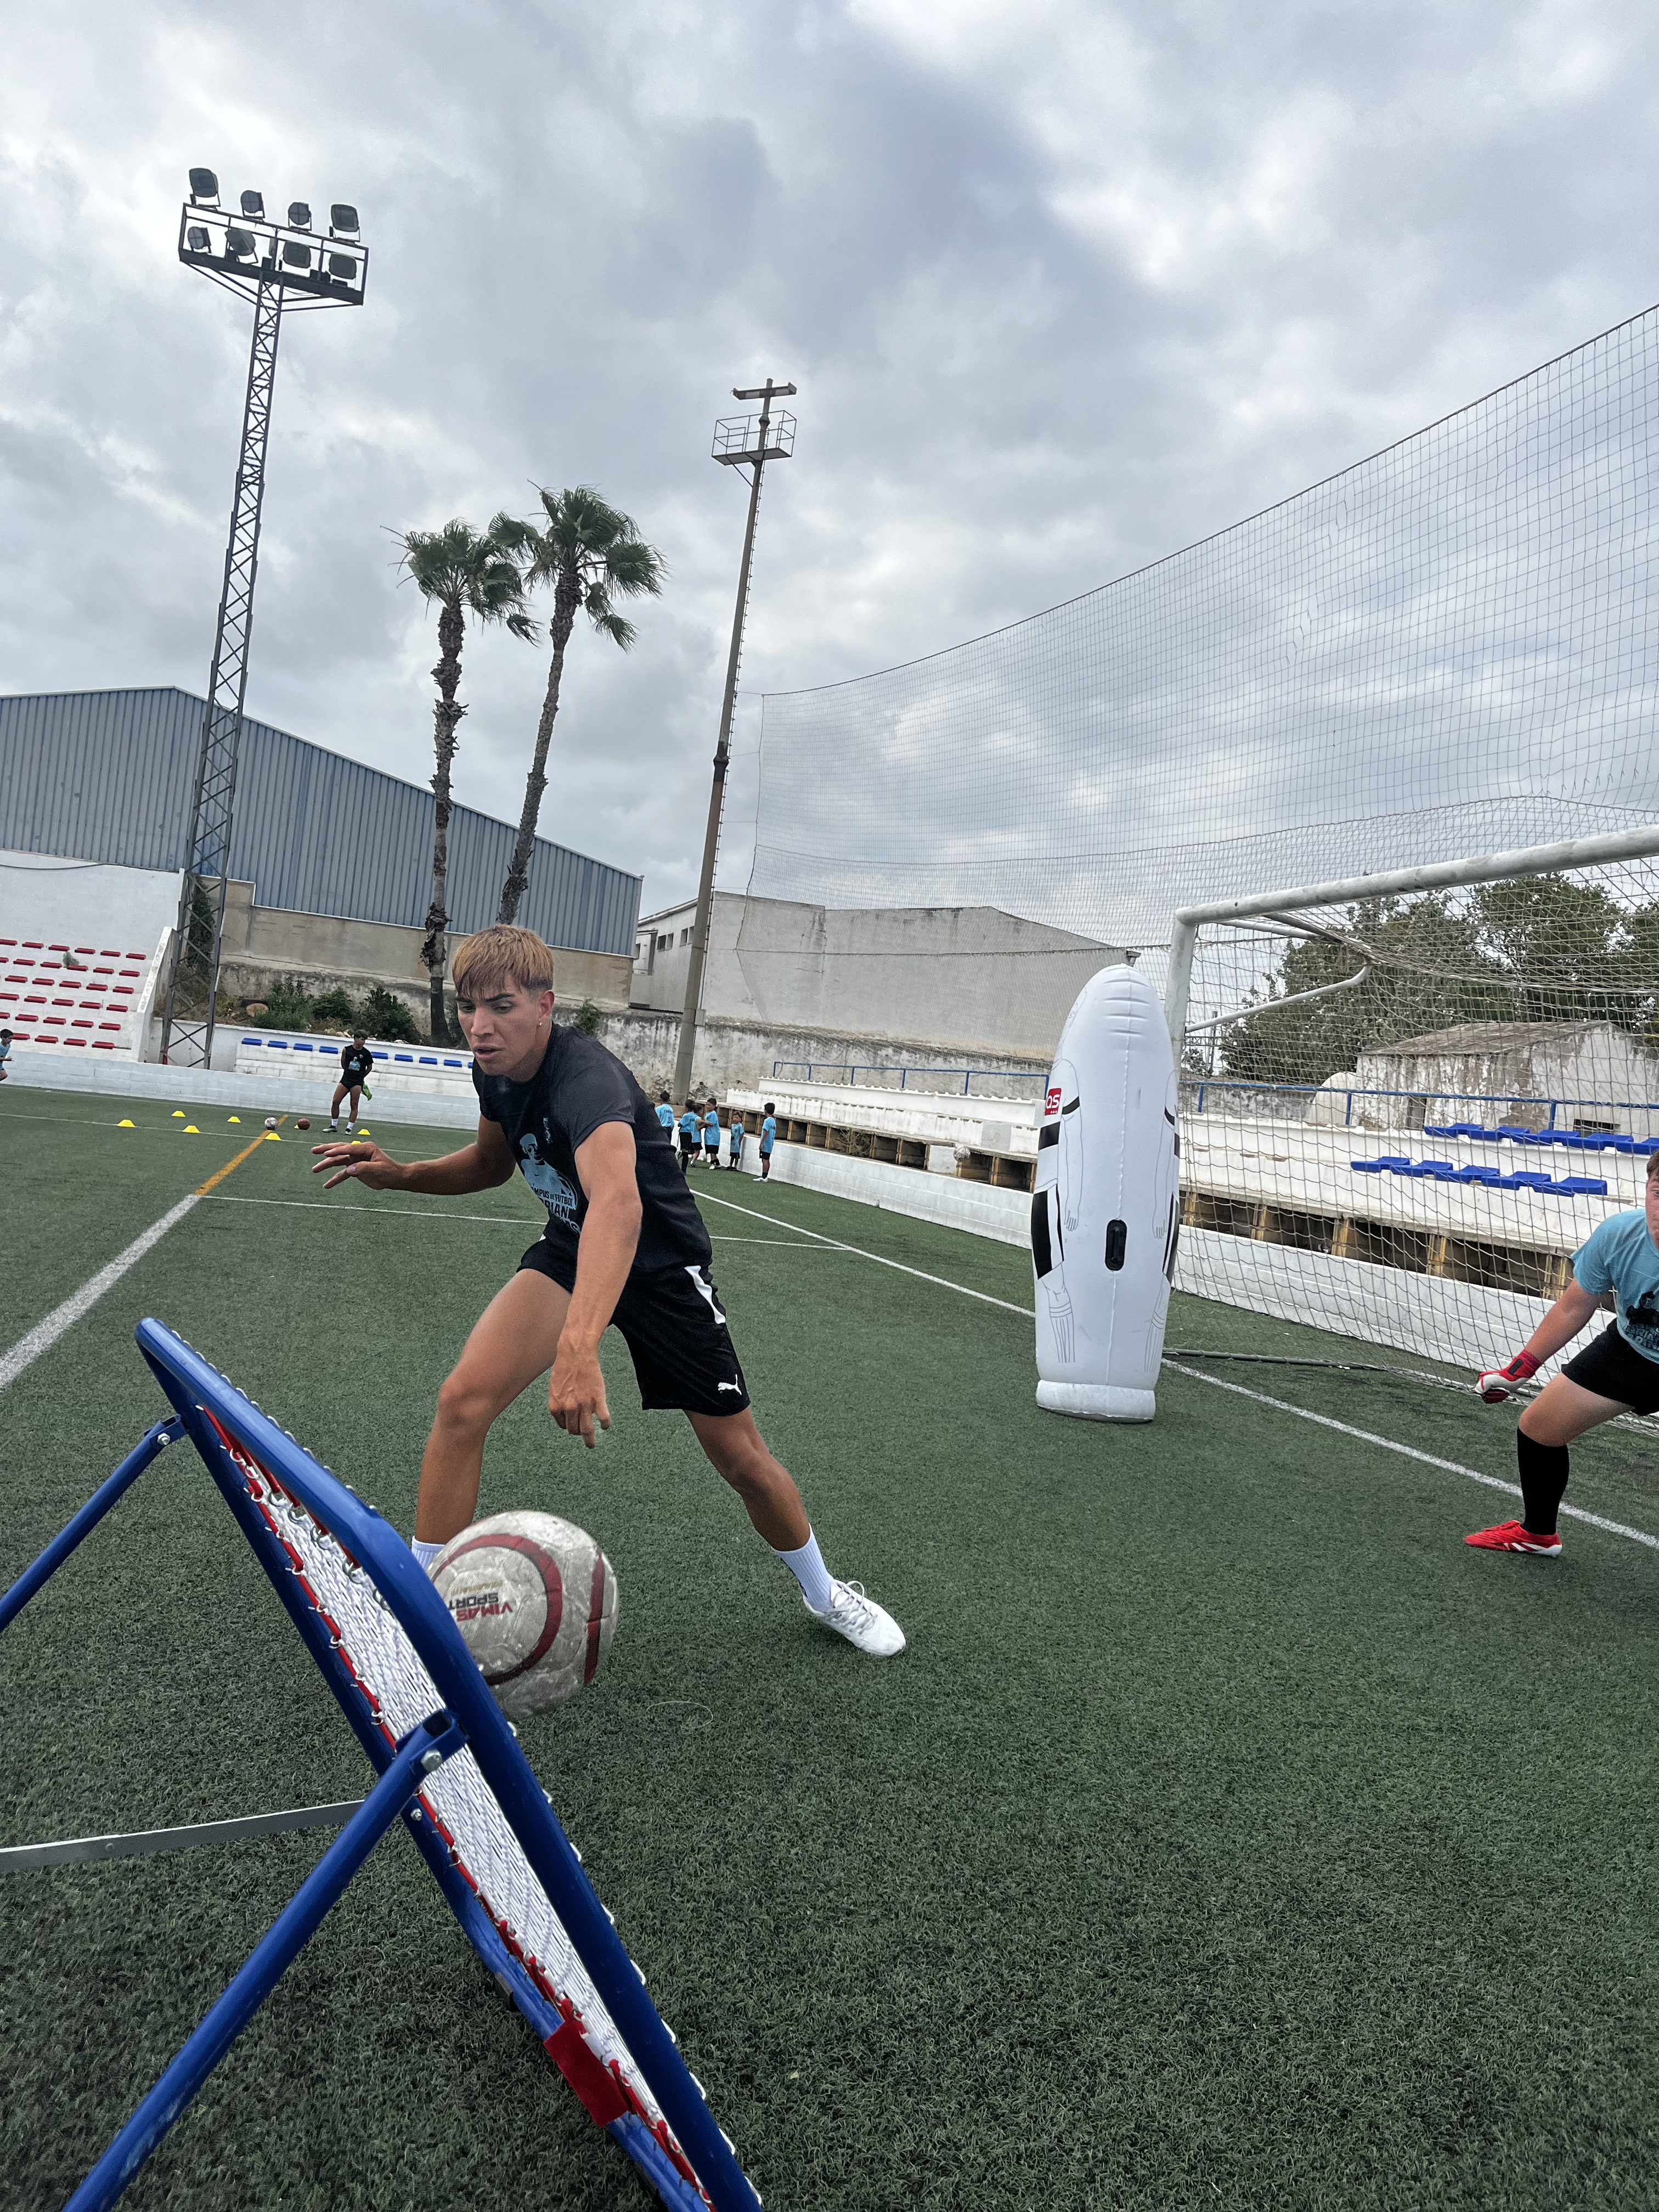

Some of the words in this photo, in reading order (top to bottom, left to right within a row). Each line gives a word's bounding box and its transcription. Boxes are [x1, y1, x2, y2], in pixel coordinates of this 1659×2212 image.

[555, 1194, 573, 1207] FUTBOL
[449, 1592, 499, 1610] SPORT
[456, 1601, 513, 1622] VIMAS
